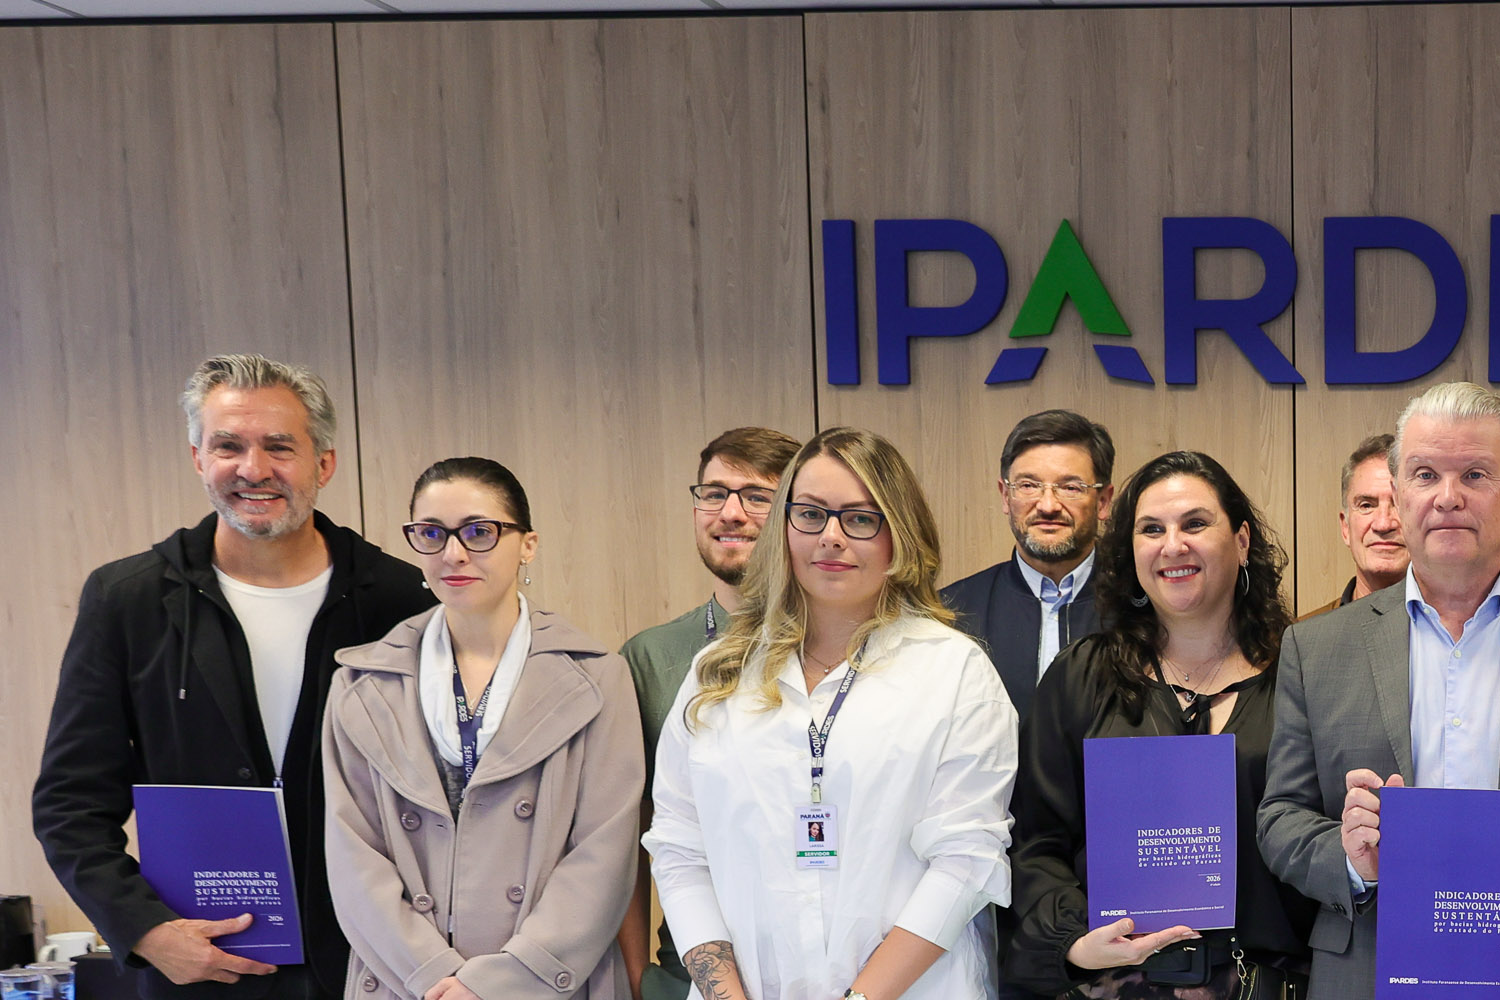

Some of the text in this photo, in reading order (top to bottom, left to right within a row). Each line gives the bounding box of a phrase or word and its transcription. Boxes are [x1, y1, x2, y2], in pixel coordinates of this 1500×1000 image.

[1137, 826, 1221, 837] INDICADORES DE
[1138, 835, 1221, 846] DESENVOLVIMENTO
[1138, 844, 1221, 855] SUSTENTÁVEL
[264, 871, 277, 879] DE
[195, 887, 280, 895] SUSTENTÁVEL
[1101, 909, 1127, 917] IPARDES
